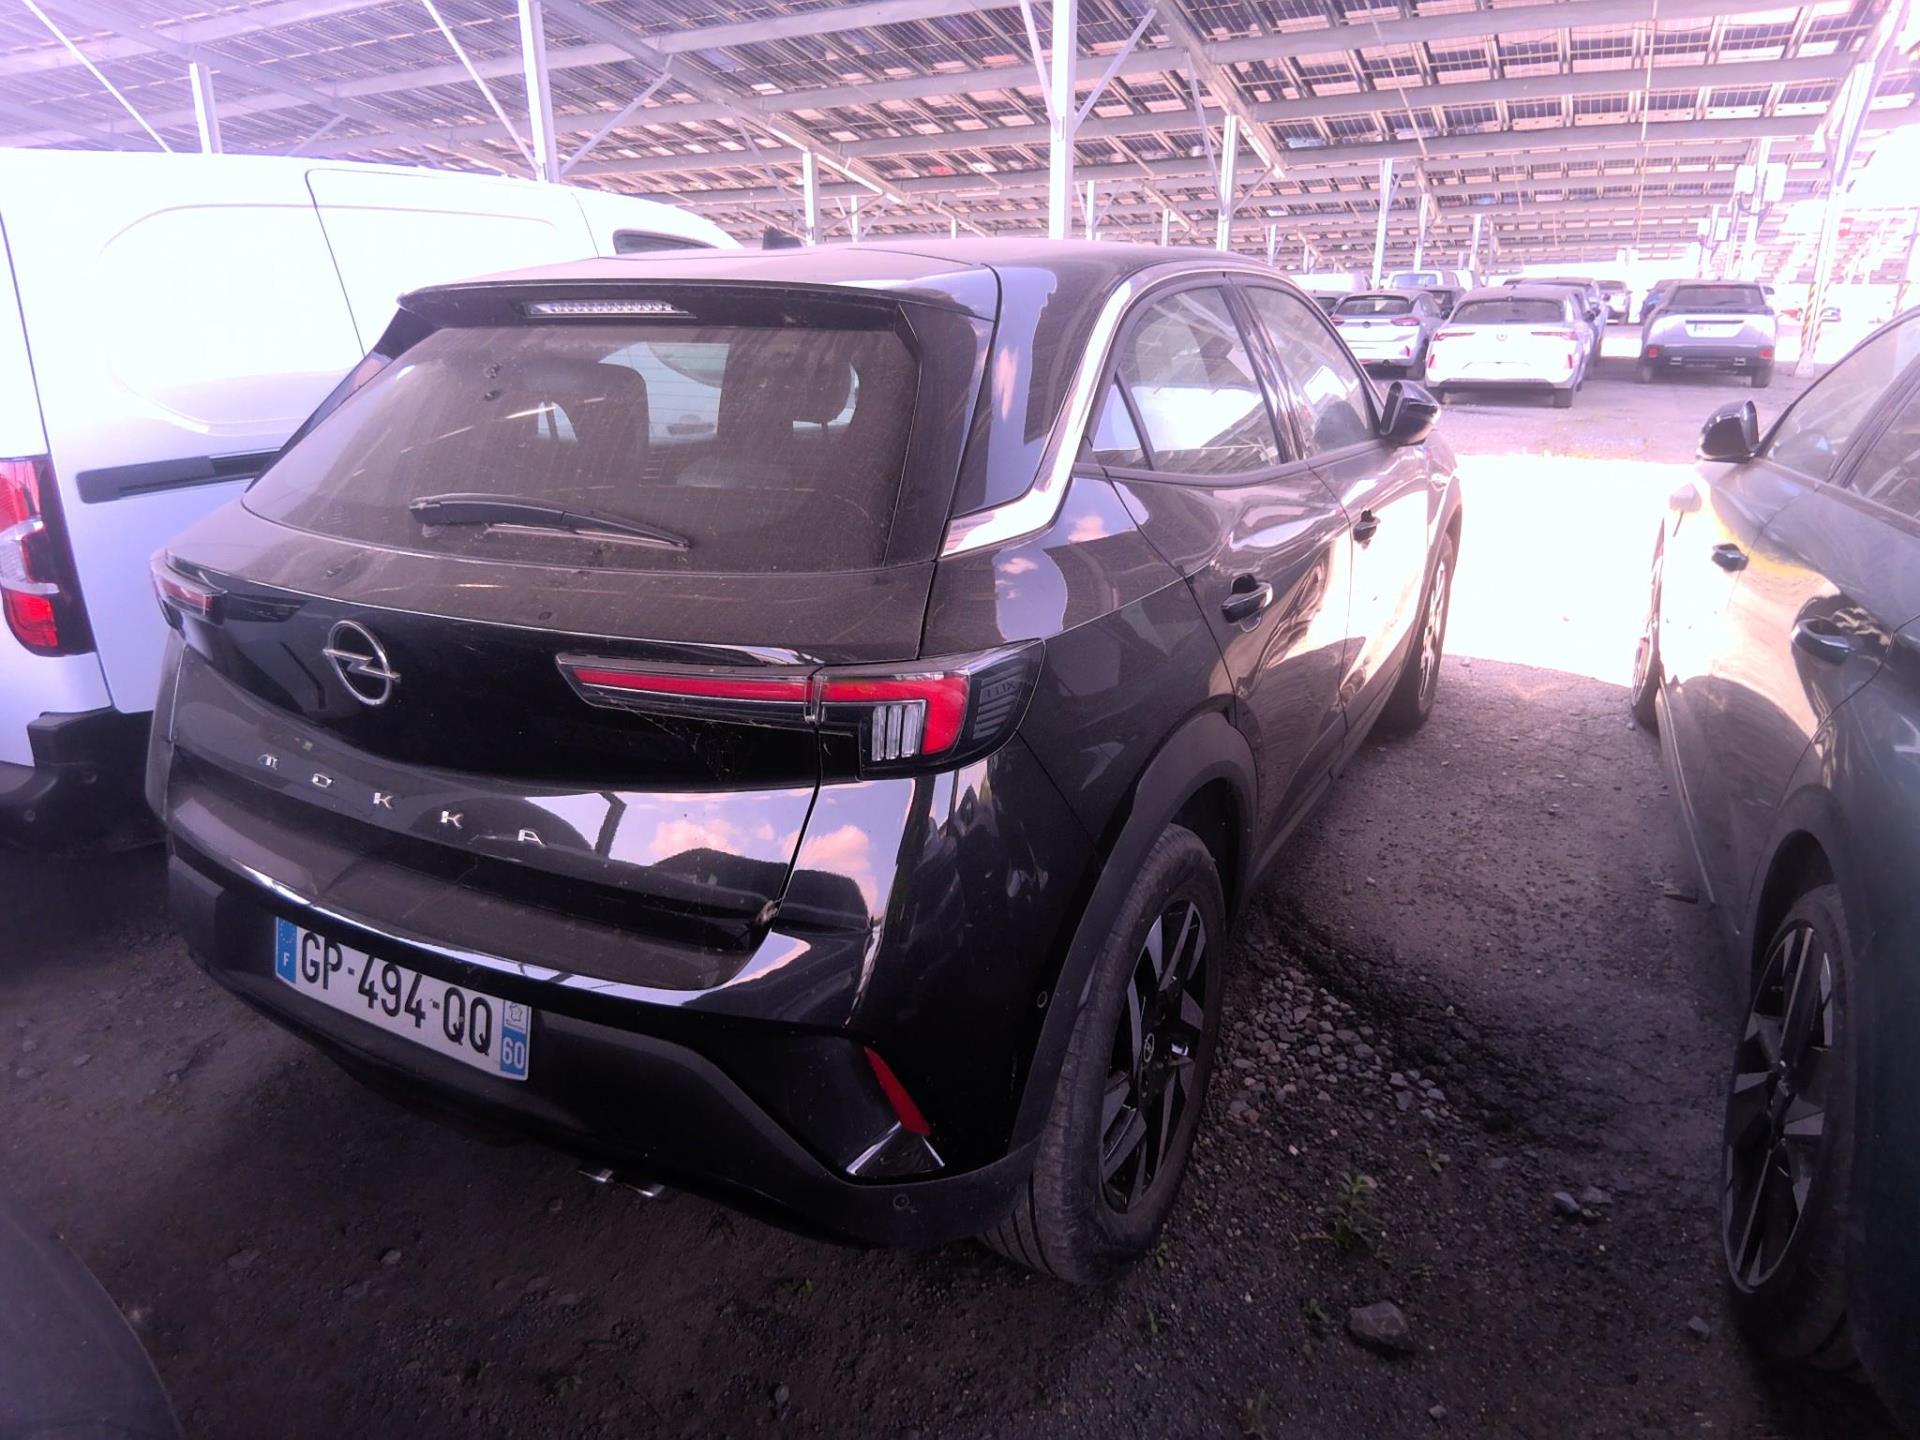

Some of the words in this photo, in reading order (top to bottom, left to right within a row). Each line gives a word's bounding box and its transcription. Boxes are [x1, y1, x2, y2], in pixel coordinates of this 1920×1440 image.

[283, 953, 290, 967] F
[301, 932, 492, 1057] GP-494-QQ
[502, 1036, 526, 1070] 60
